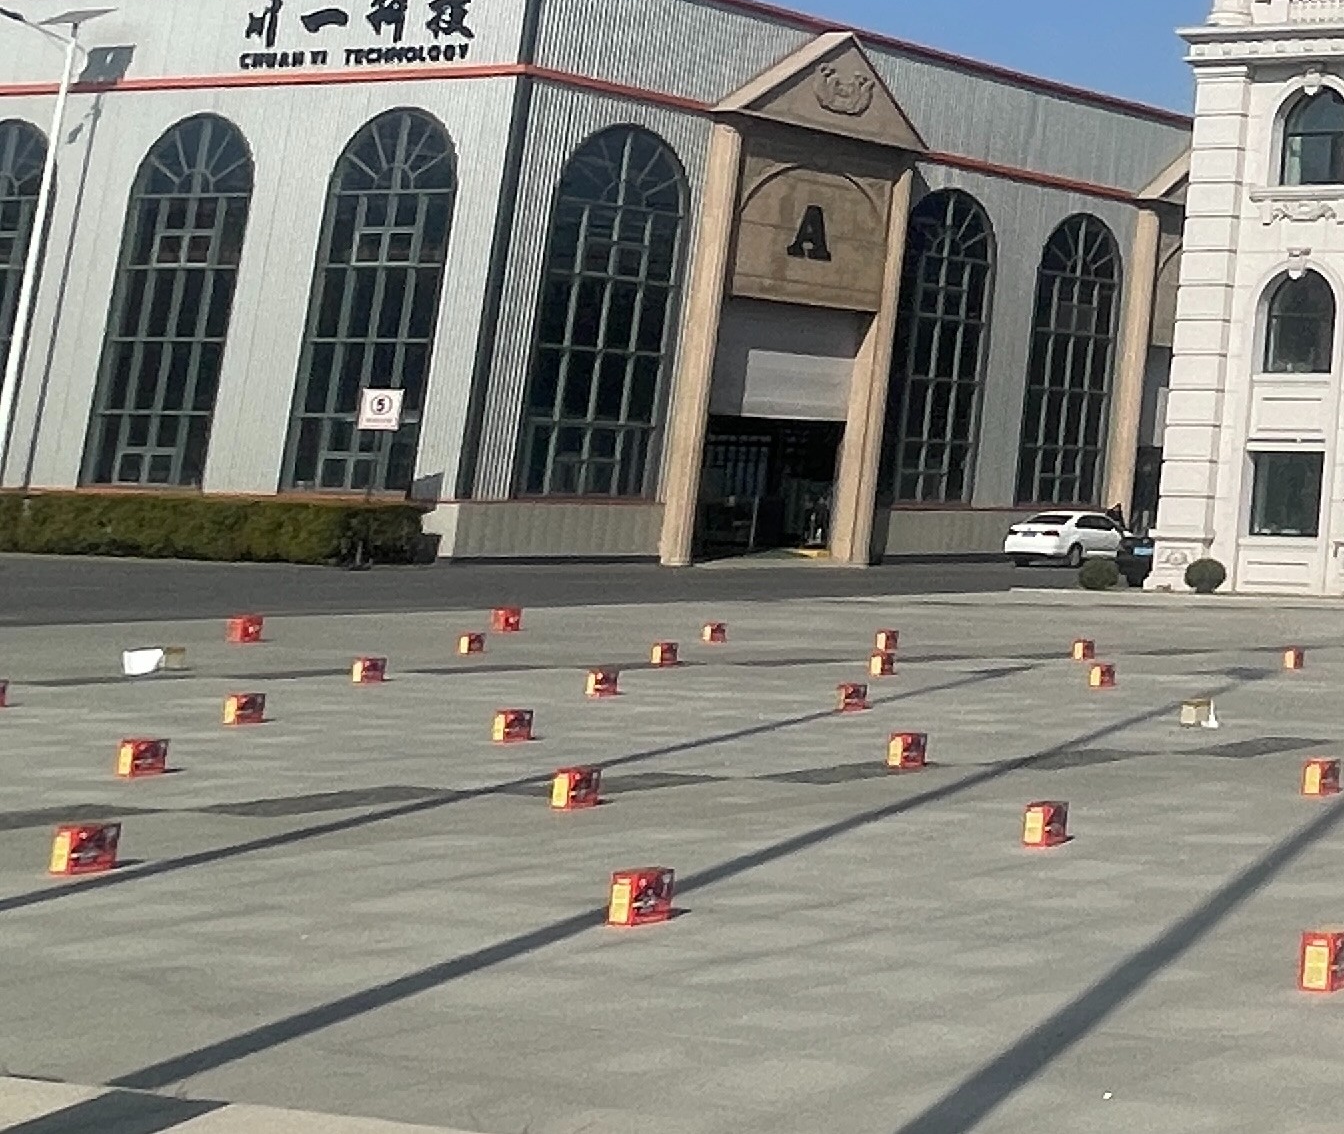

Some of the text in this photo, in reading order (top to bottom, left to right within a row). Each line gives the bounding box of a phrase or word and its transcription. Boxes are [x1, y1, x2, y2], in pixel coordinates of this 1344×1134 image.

[239, 42, 470, 70] CHUAN YI TECHNOLOGY
[786, 203, 832, 262] A
[376, 398, 385, 412] 5
